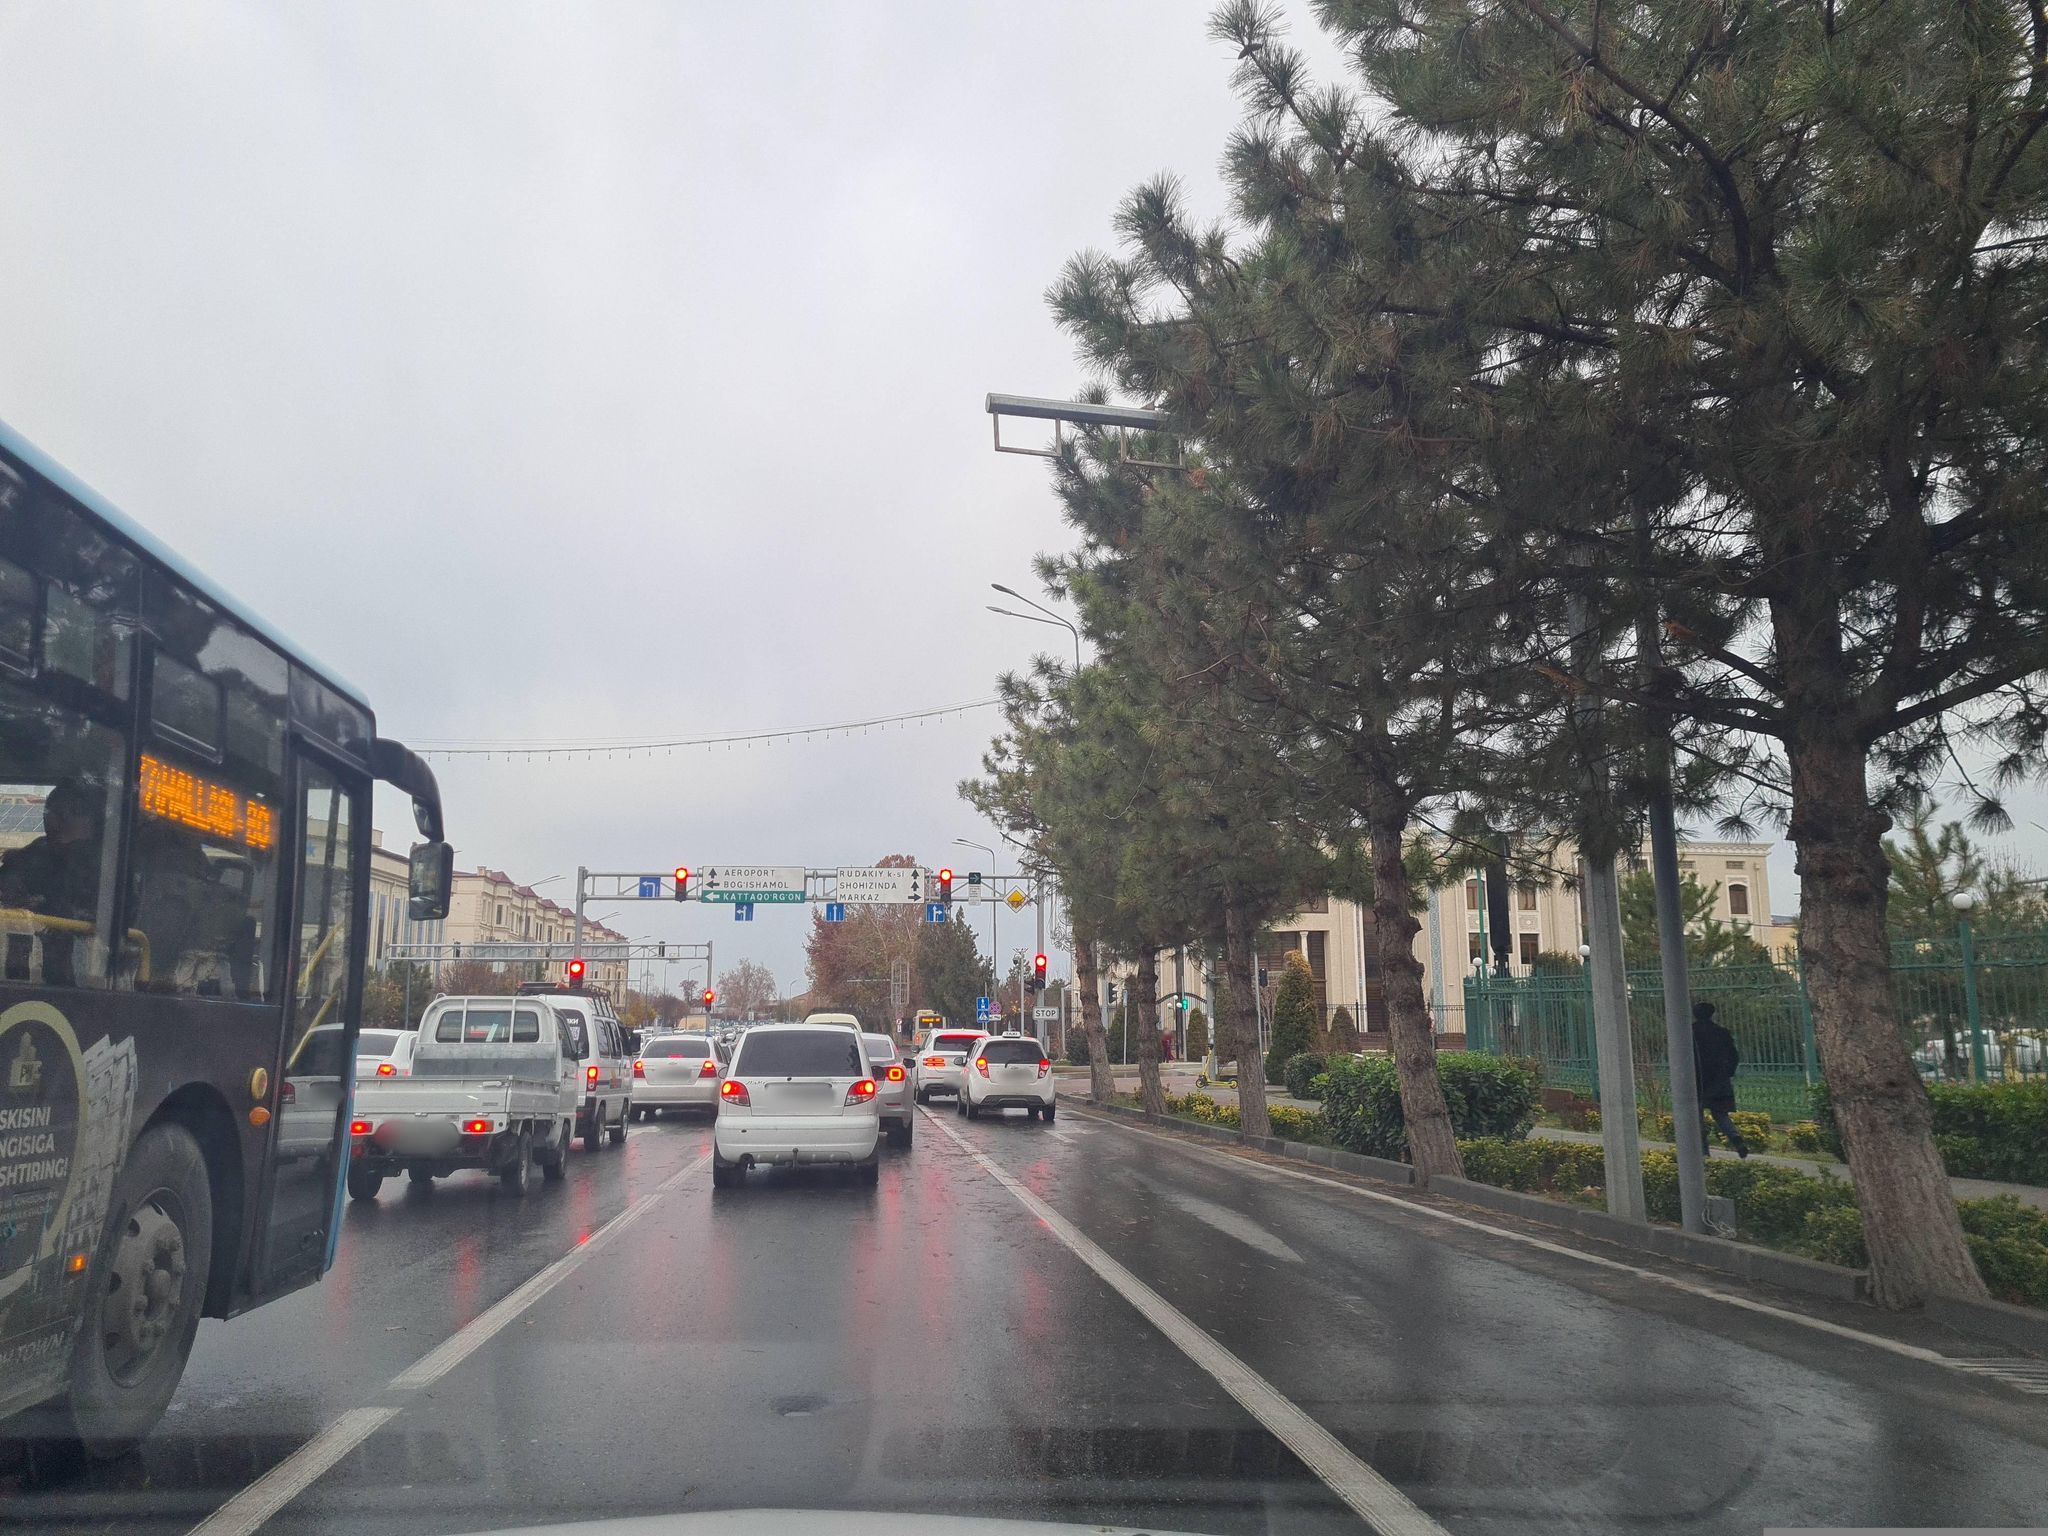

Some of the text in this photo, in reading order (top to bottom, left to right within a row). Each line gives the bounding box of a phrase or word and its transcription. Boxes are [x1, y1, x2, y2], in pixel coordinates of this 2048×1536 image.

[724, 869, 776, 877] AEROPORT
[839, 870, 884, 878] RUDAKIY
[839, 882, 897, 890] SHOHIZINDA
[839, 893, 880, 901] MARKAZ
